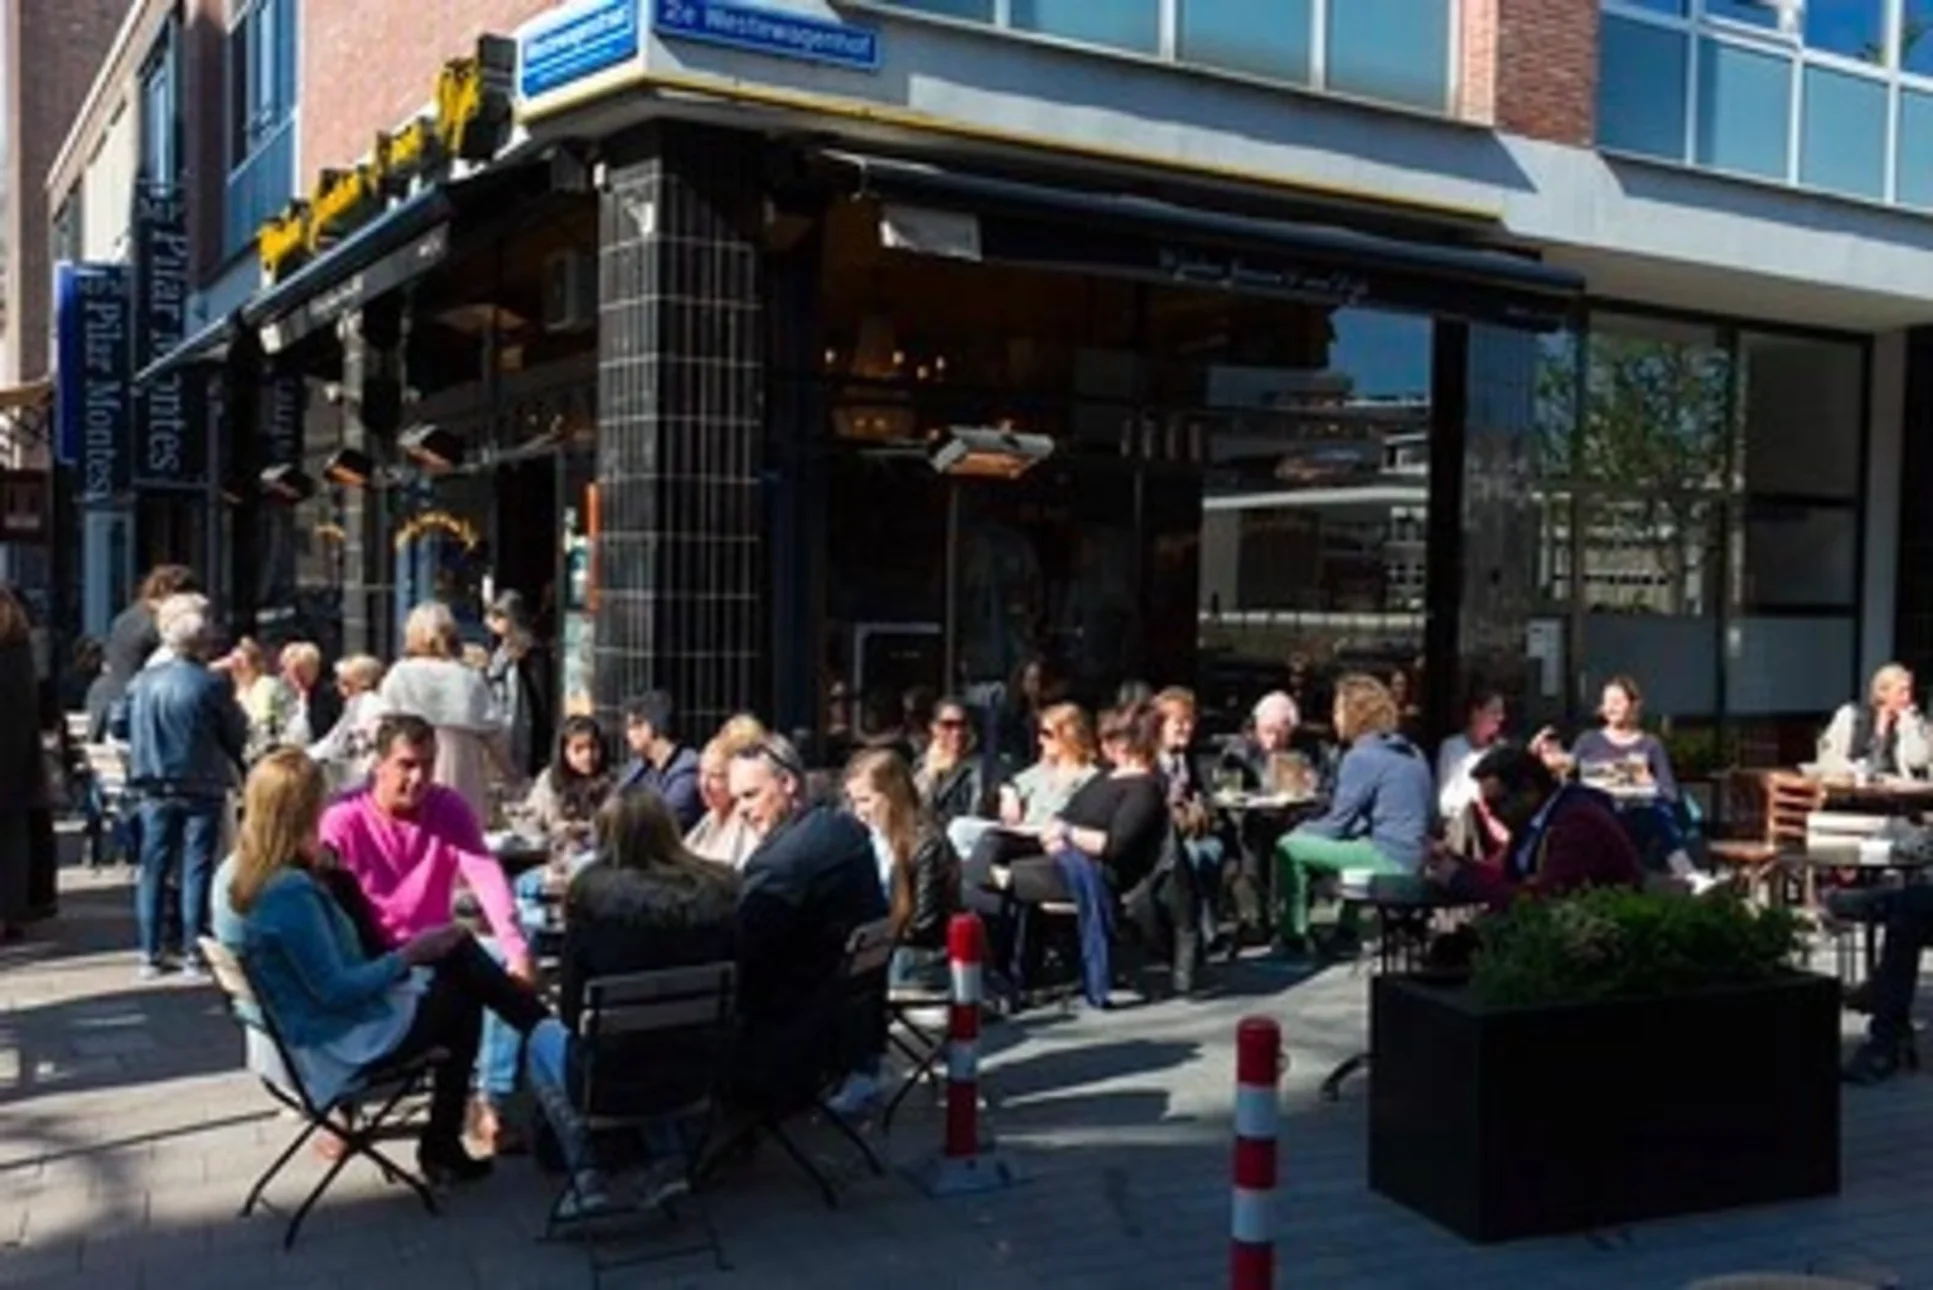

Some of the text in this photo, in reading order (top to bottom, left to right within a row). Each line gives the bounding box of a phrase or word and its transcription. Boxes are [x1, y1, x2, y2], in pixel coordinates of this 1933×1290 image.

[150, 228, 190, 322] Pilar
[84, 300, 121, 495] Pilar Montes
